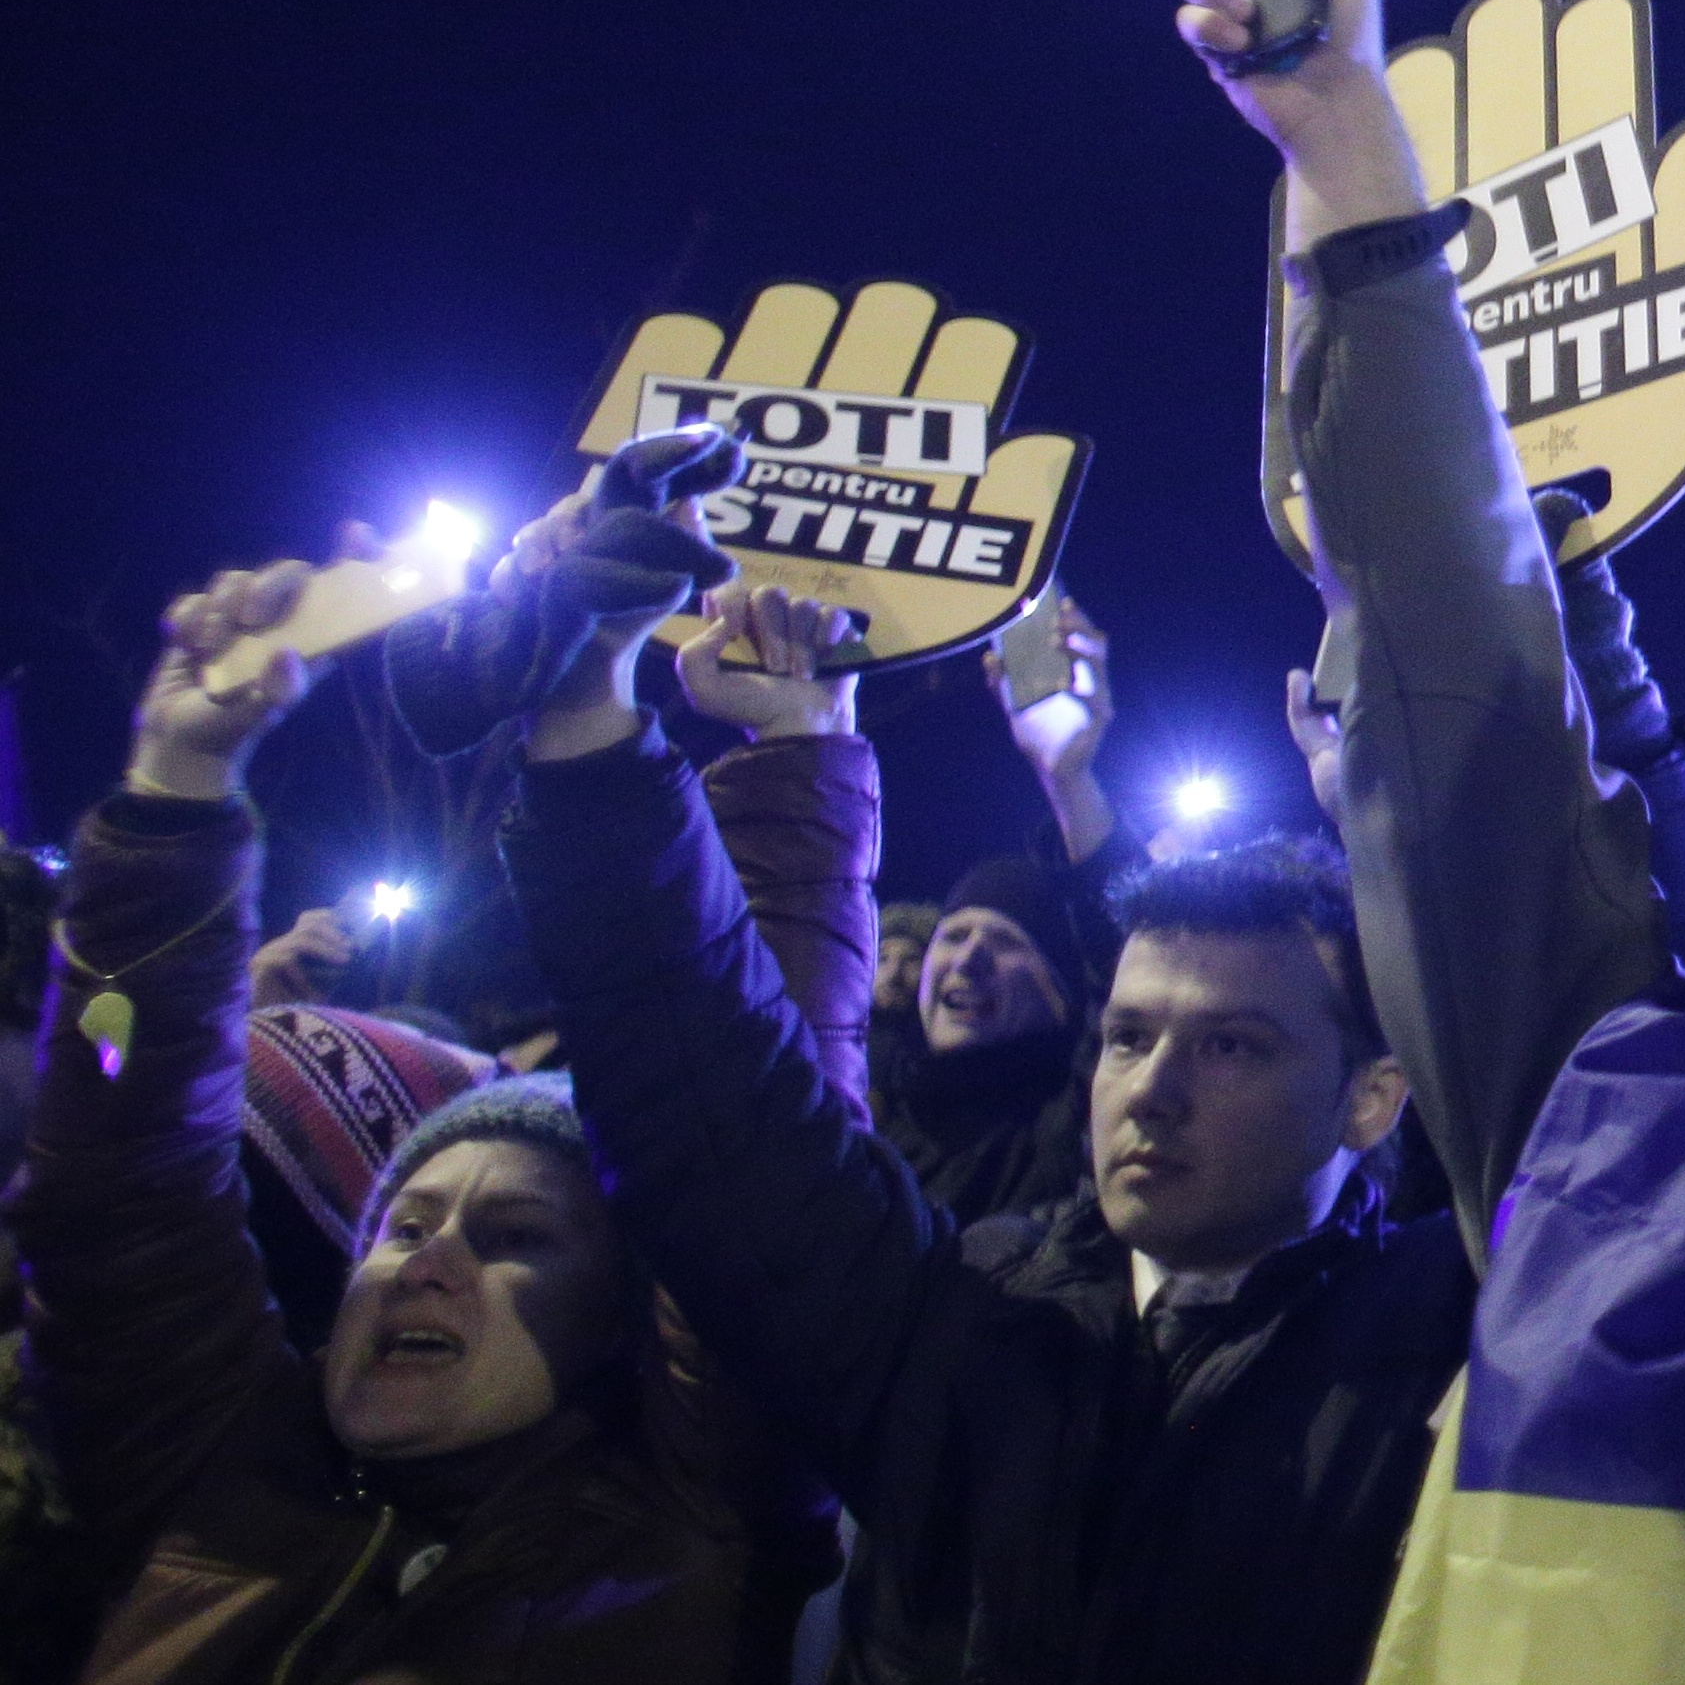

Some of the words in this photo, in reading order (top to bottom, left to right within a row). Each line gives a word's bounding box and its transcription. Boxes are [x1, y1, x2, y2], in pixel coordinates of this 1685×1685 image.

[1455, 141, 1618, 287] ȚI
[746, 462, 917, 505] pentru
[704, 487, 1014, 577] STIȚIE
